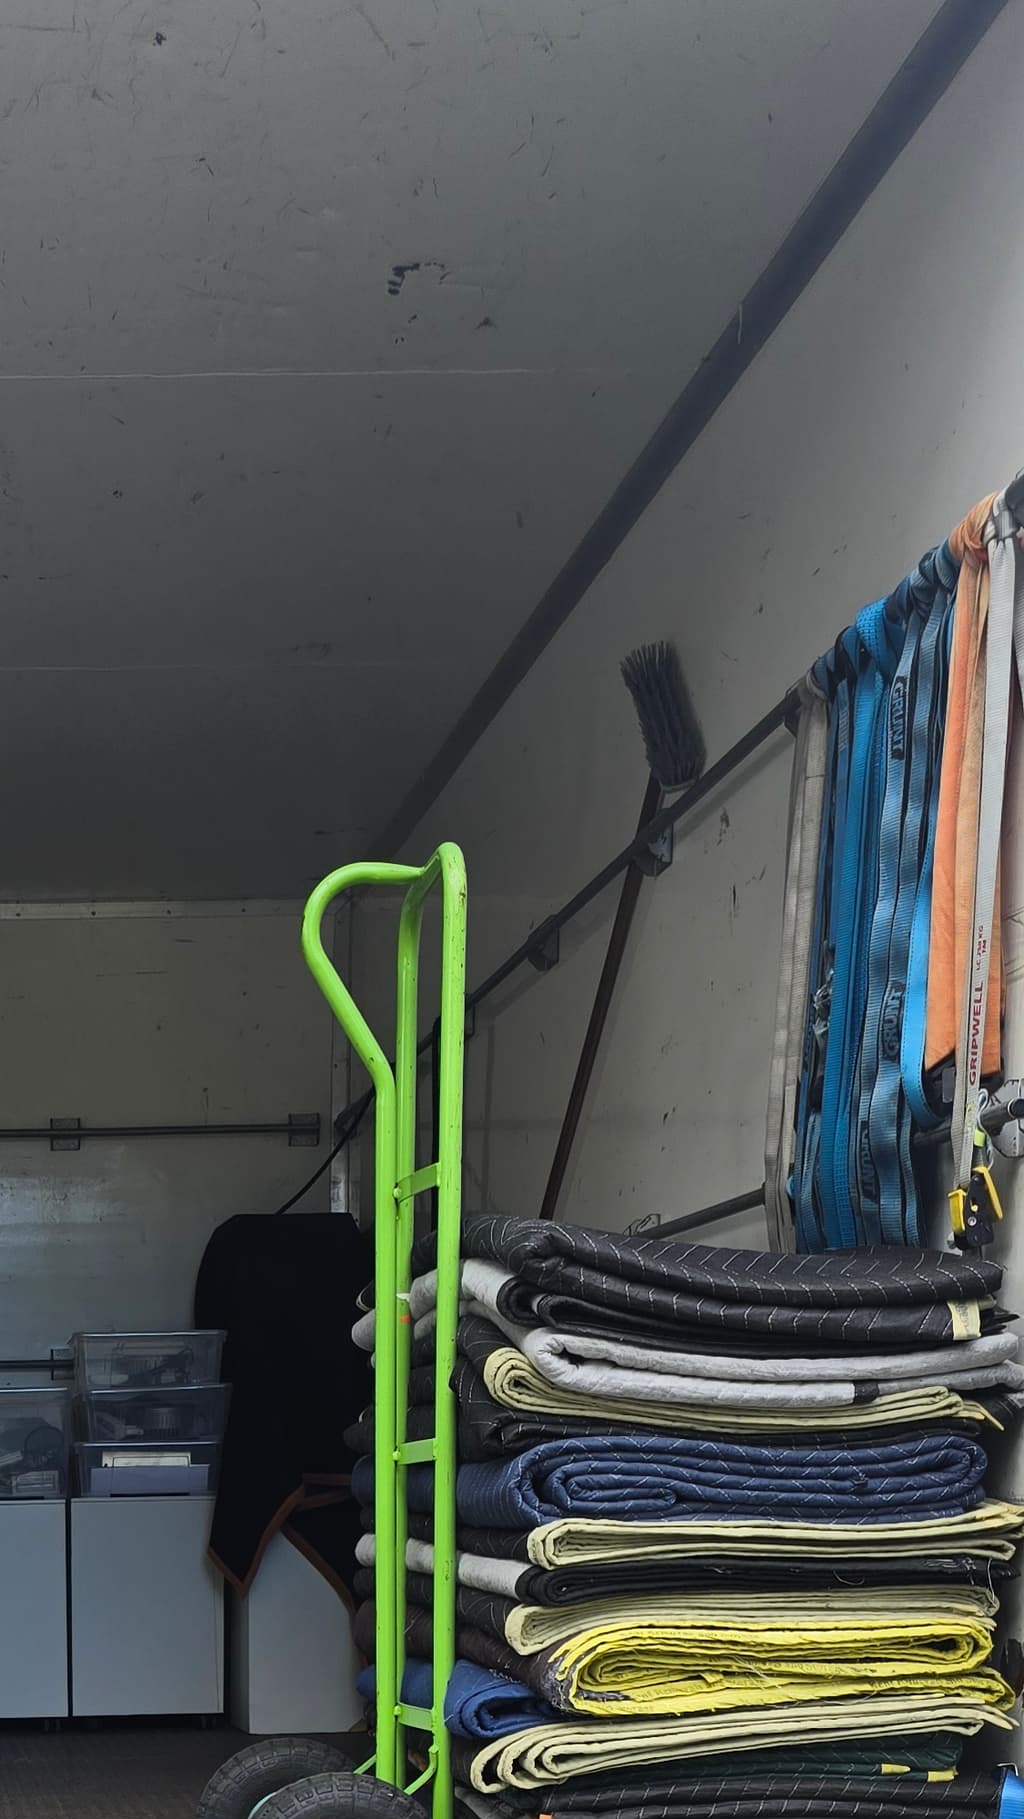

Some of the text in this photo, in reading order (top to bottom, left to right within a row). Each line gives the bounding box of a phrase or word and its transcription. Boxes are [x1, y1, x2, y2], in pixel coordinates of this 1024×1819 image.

[892, 681, 904, 752] GRUNT
[883, 988, 904, 1056] GRUNT
[969, 980, 984, 1086] GRIPWELL
